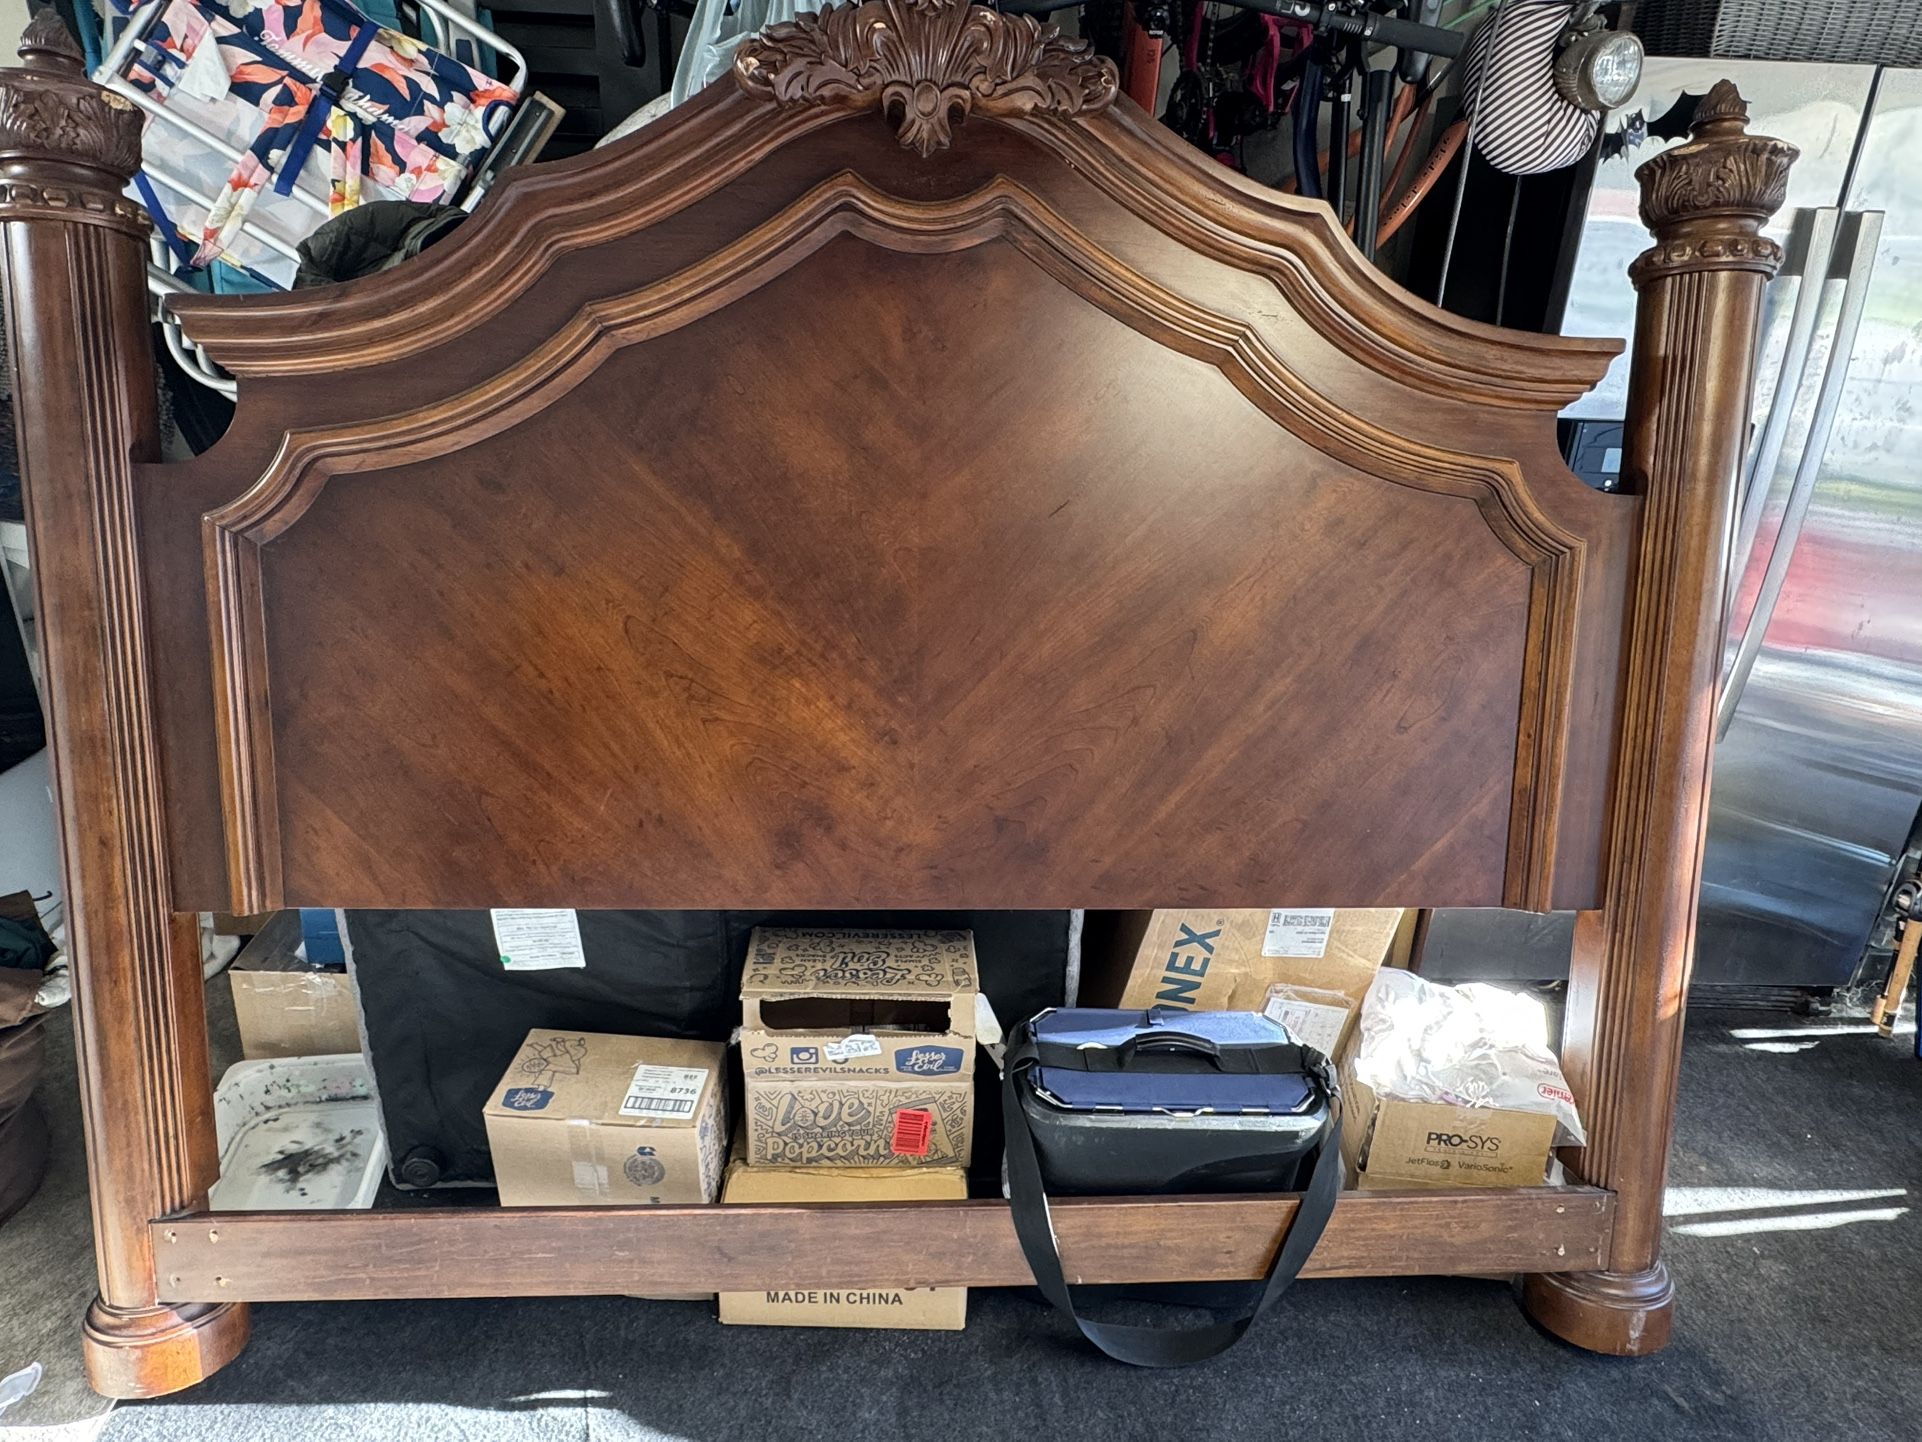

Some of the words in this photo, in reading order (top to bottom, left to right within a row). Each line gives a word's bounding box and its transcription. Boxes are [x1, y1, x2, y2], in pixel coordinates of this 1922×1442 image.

[345, 78, 410, 132] ahama
[670, 1087, 697, 1095] 8736
[766, 1136, 890, 1164] Popcorn
[1426, 1132, 1500, 1151] PRO-SYS
[766, 1291, 819, 1304] MADE
[823, 1292, 841, 1304] IN
[846, 1292, 903, 1305] CHINA
